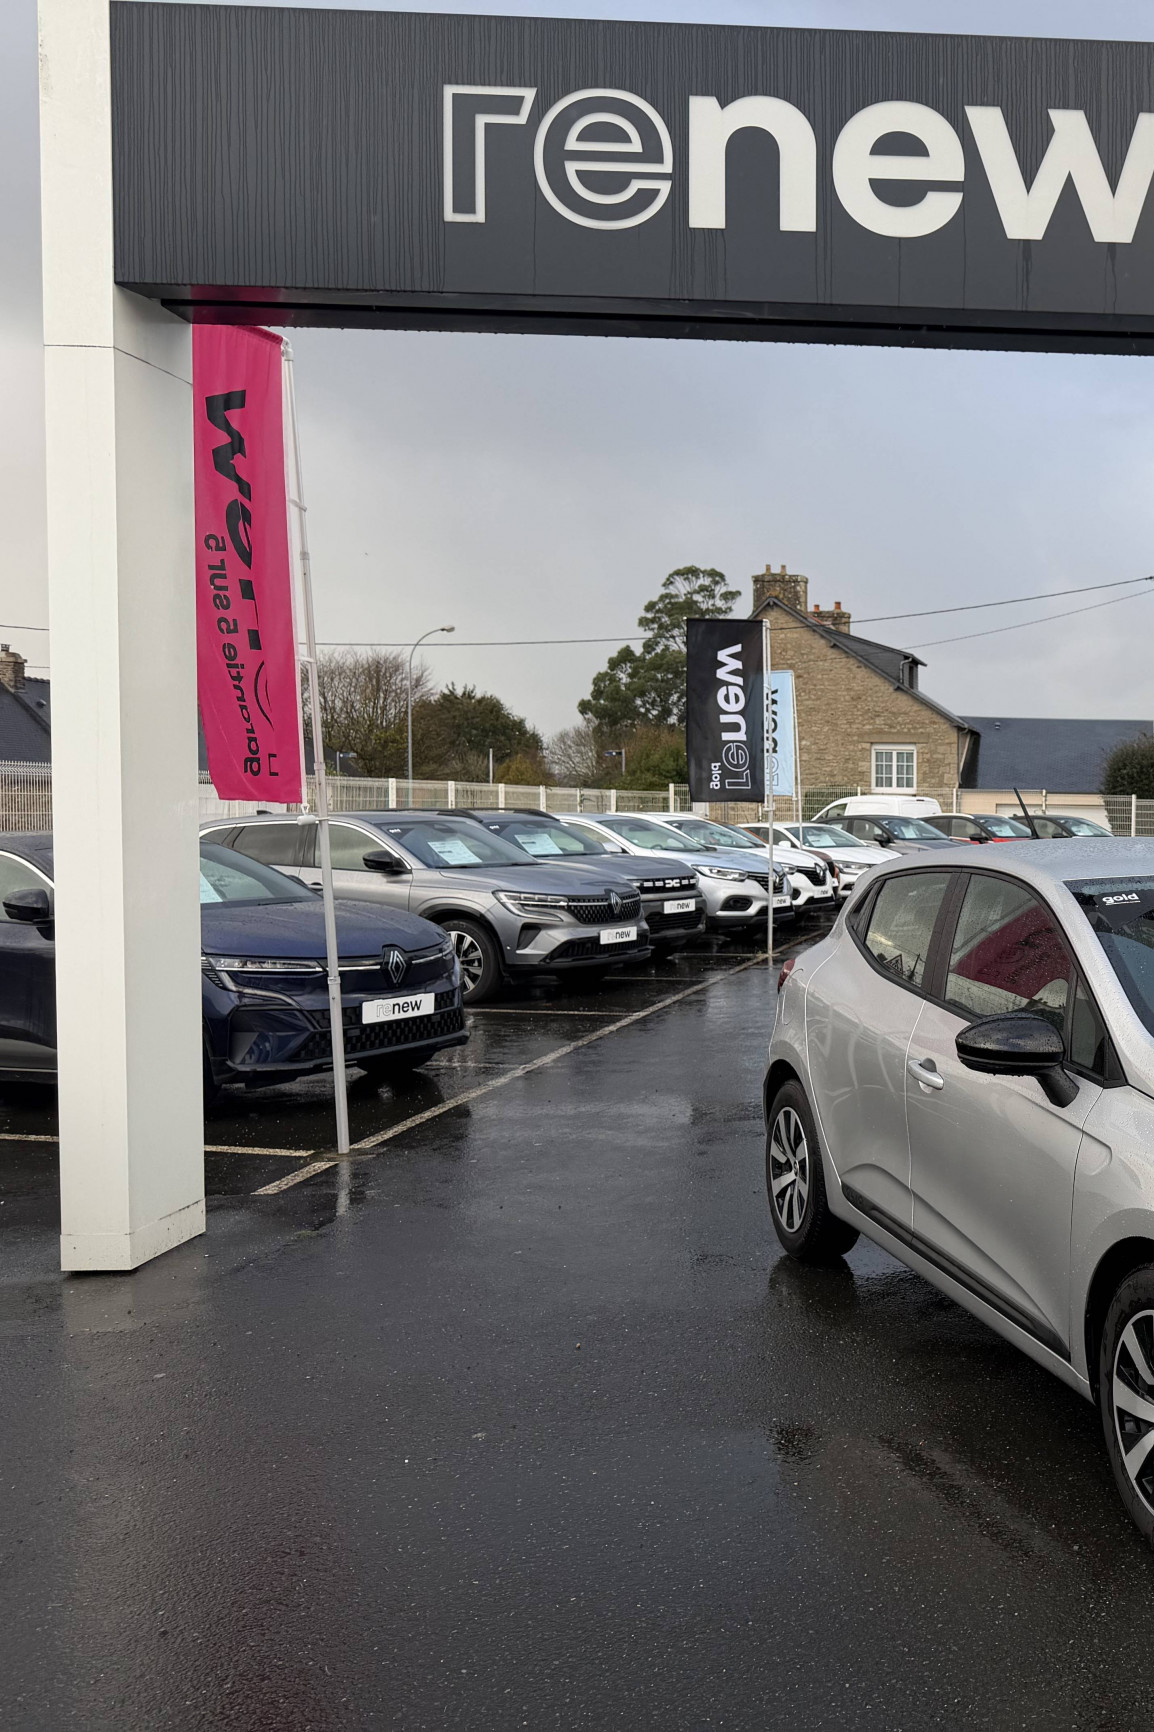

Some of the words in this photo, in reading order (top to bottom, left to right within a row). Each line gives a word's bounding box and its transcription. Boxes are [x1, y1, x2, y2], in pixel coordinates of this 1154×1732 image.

[1102, 892, 1140, 904] gold
[607, 930, 631, 941] new
[376, 999, 423, 1018] renew
